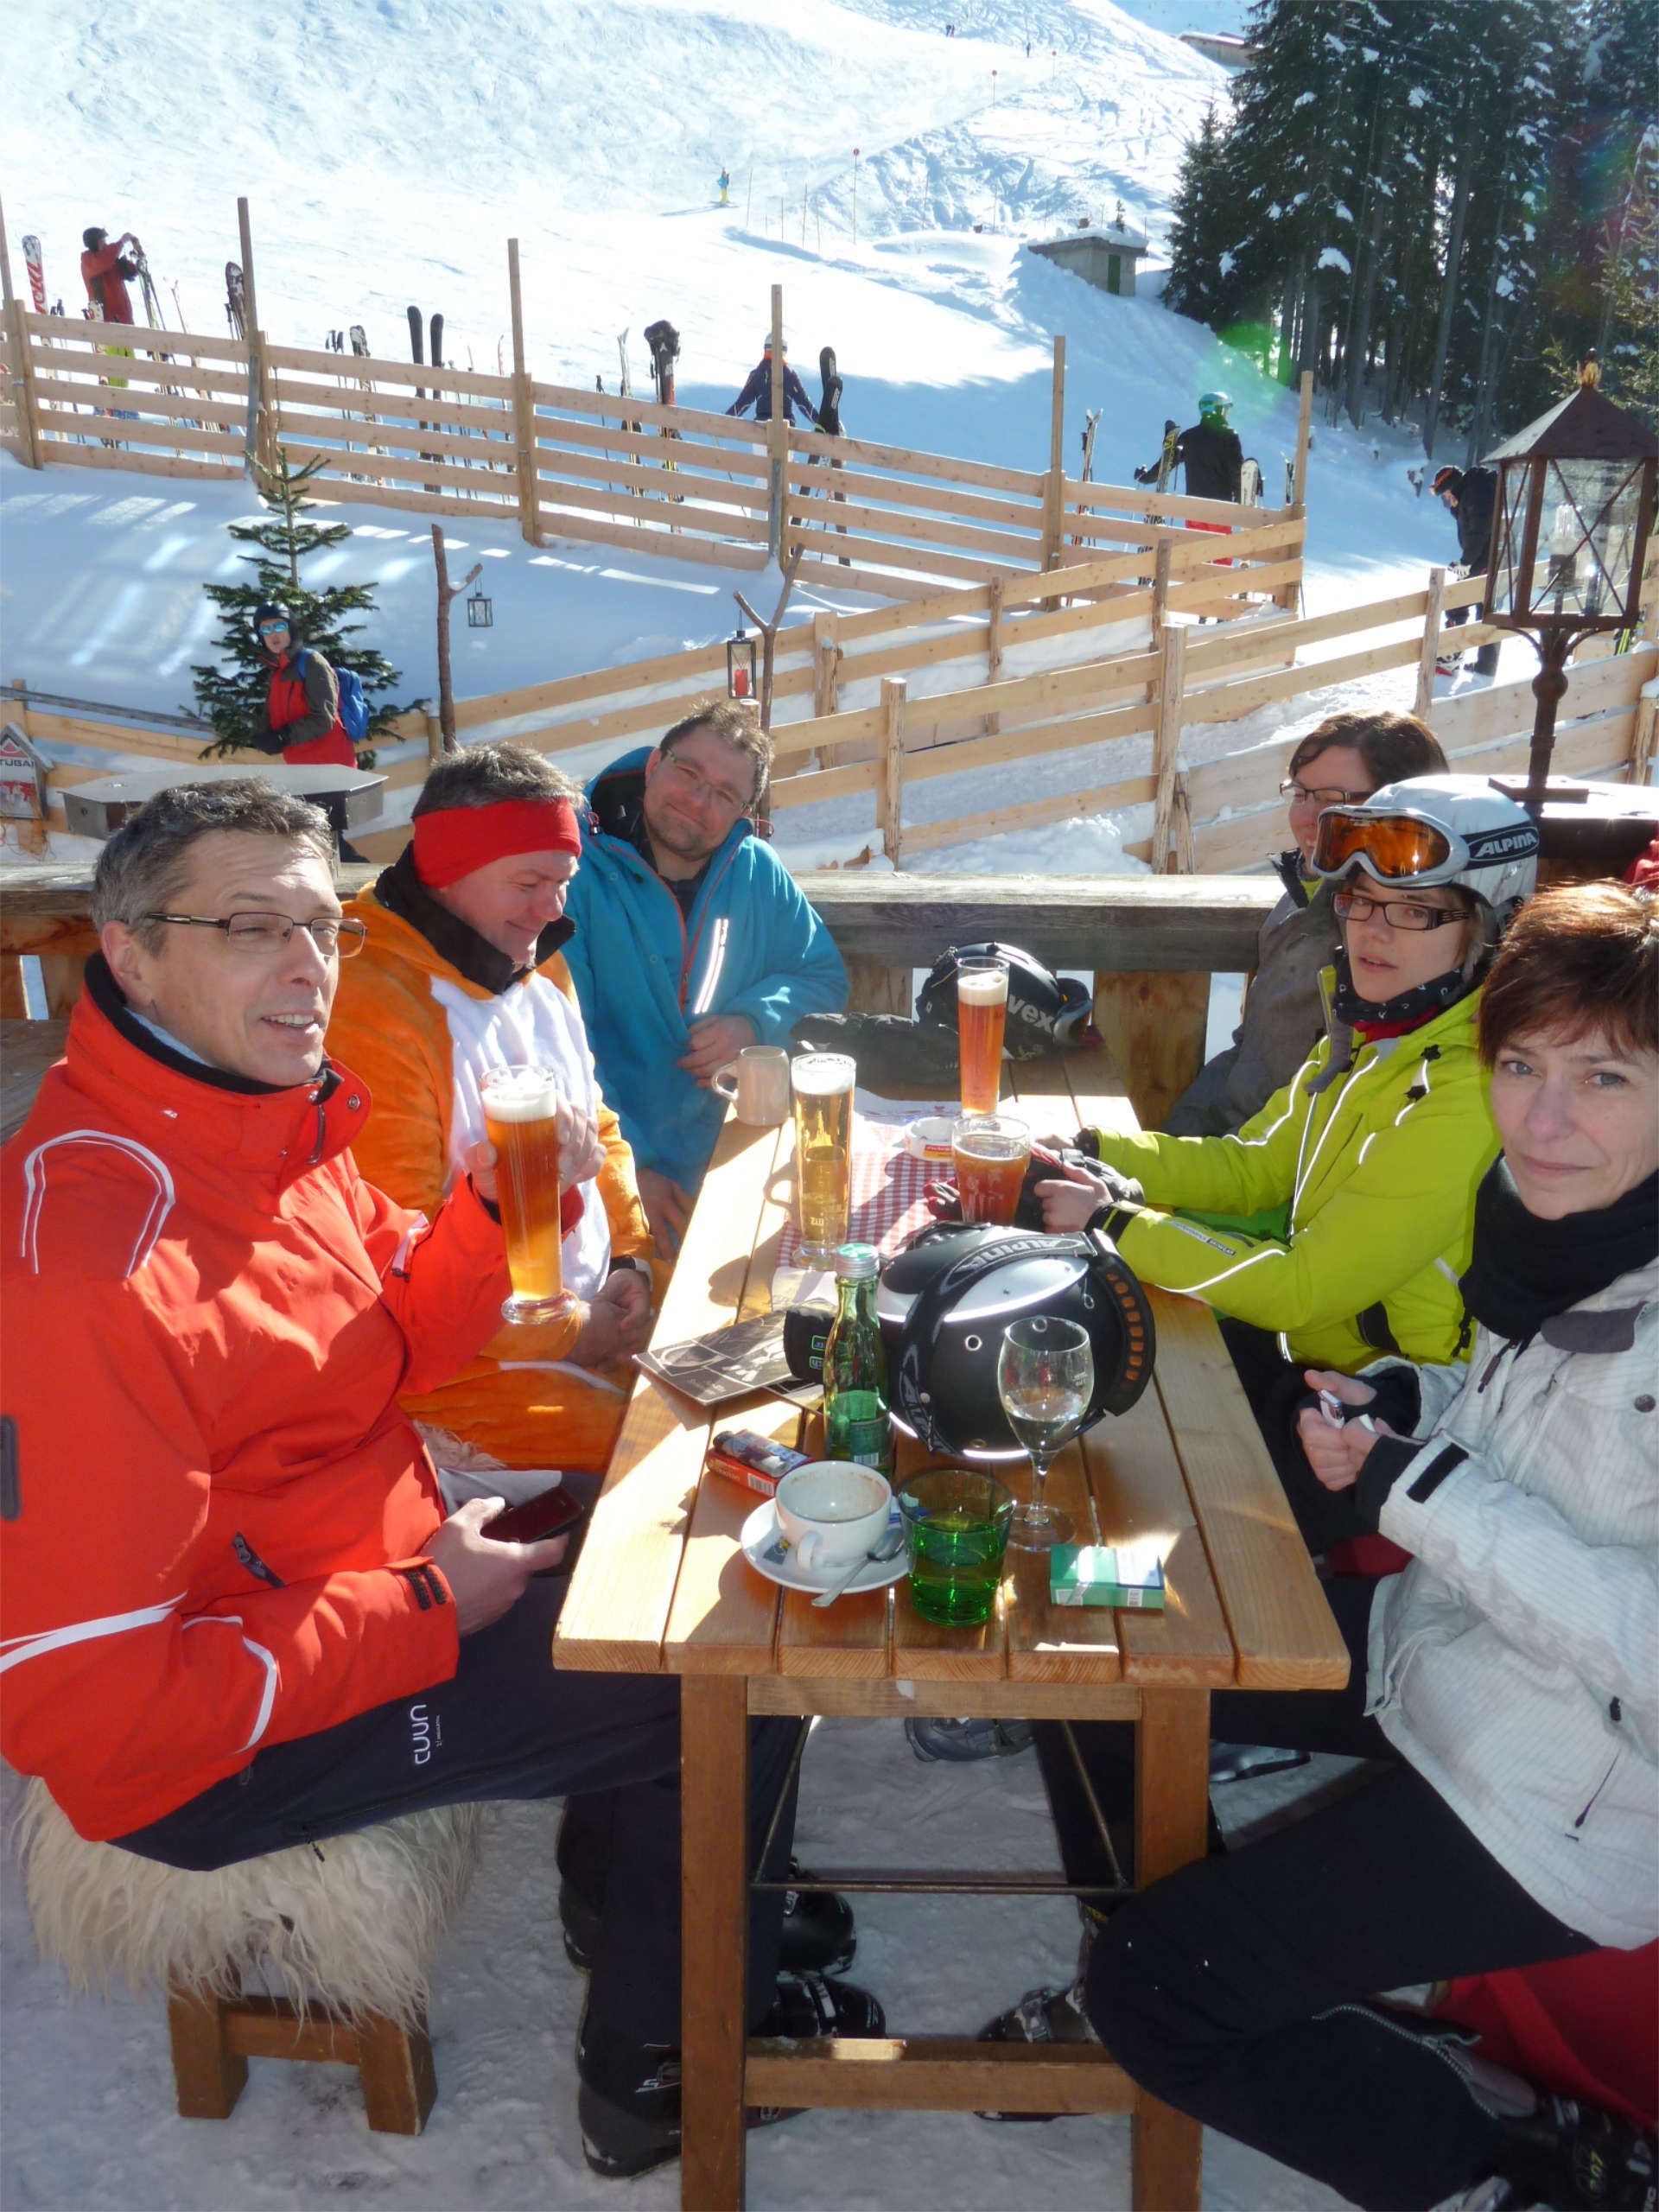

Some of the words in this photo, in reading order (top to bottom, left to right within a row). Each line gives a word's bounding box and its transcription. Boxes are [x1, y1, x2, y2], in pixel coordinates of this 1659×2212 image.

[1474, 832, 1537, 858] ALPINA
[1007, 994, 1055, 1034] vex
[955, 1238, 1062, 1274] ALPINA
